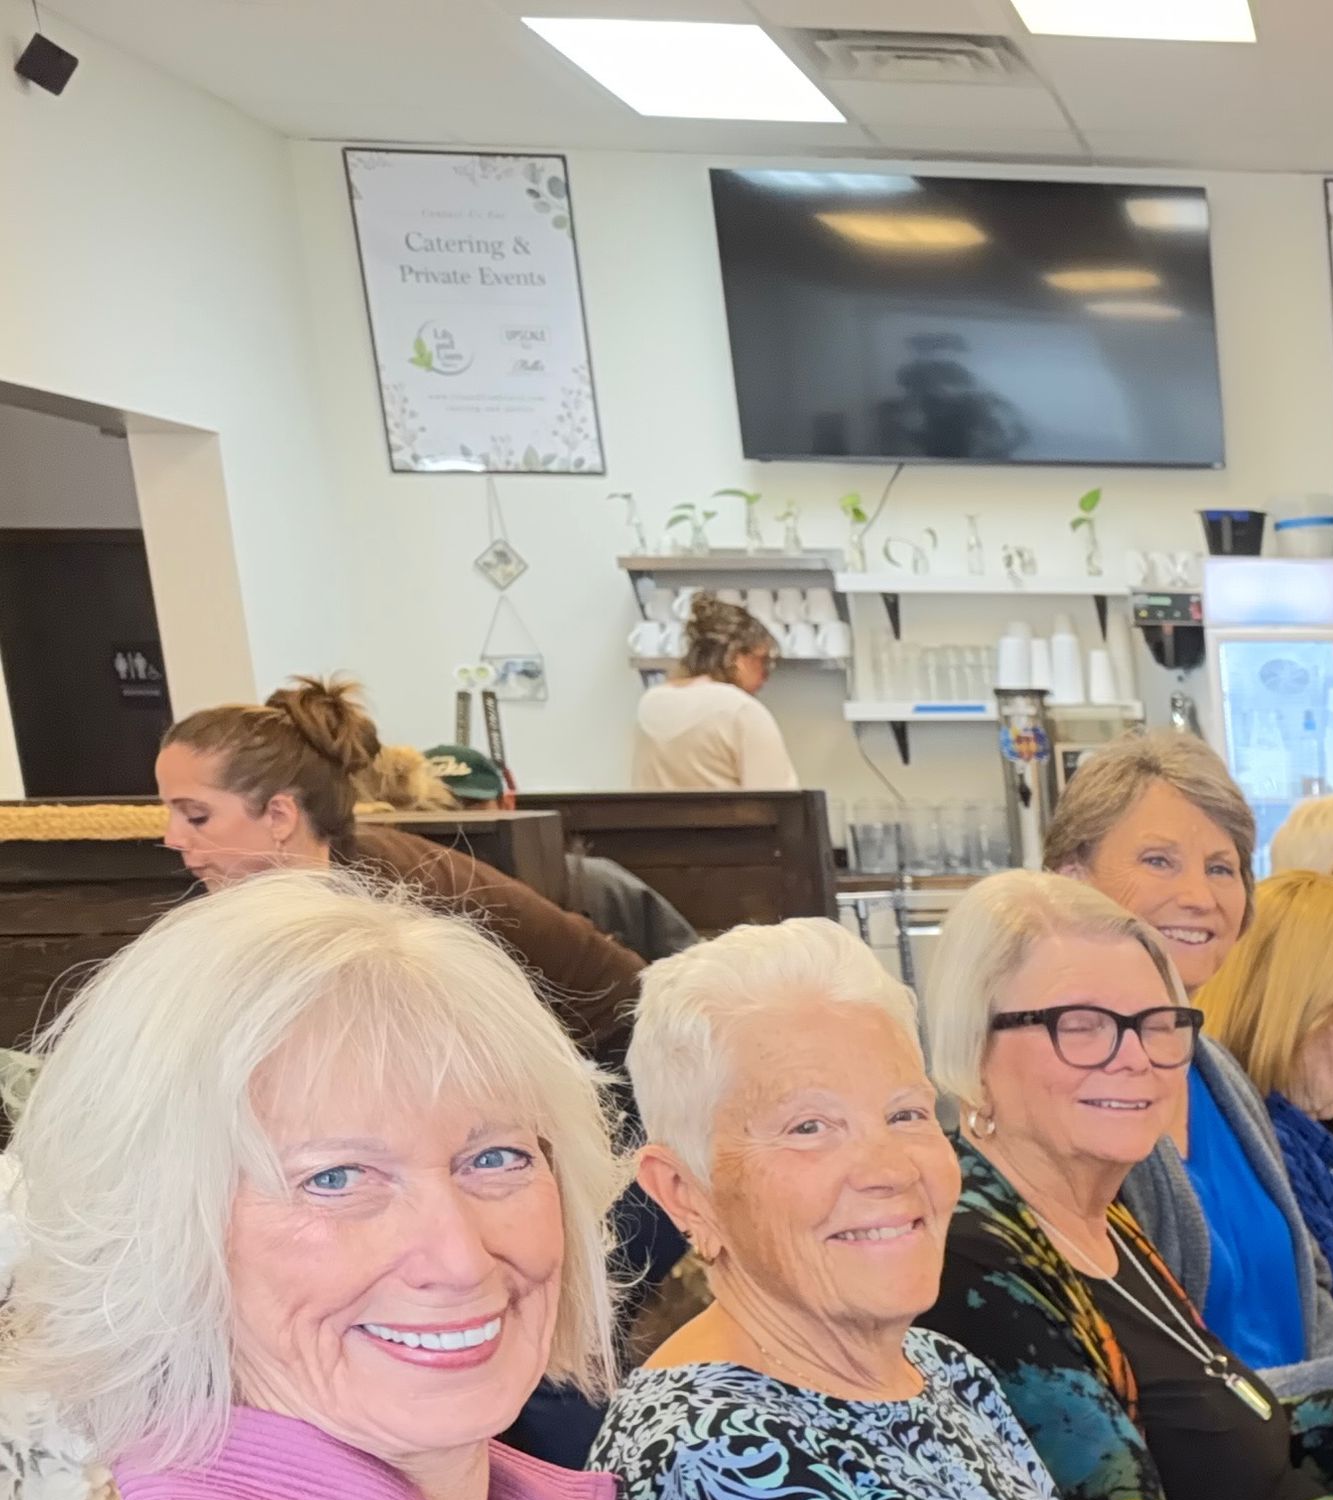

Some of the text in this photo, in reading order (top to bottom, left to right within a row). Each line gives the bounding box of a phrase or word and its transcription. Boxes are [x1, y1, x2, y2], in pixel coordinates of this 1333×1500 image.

[404, 232, 532, 260] Catering &
[399, 264, 547, 288] Private Events
